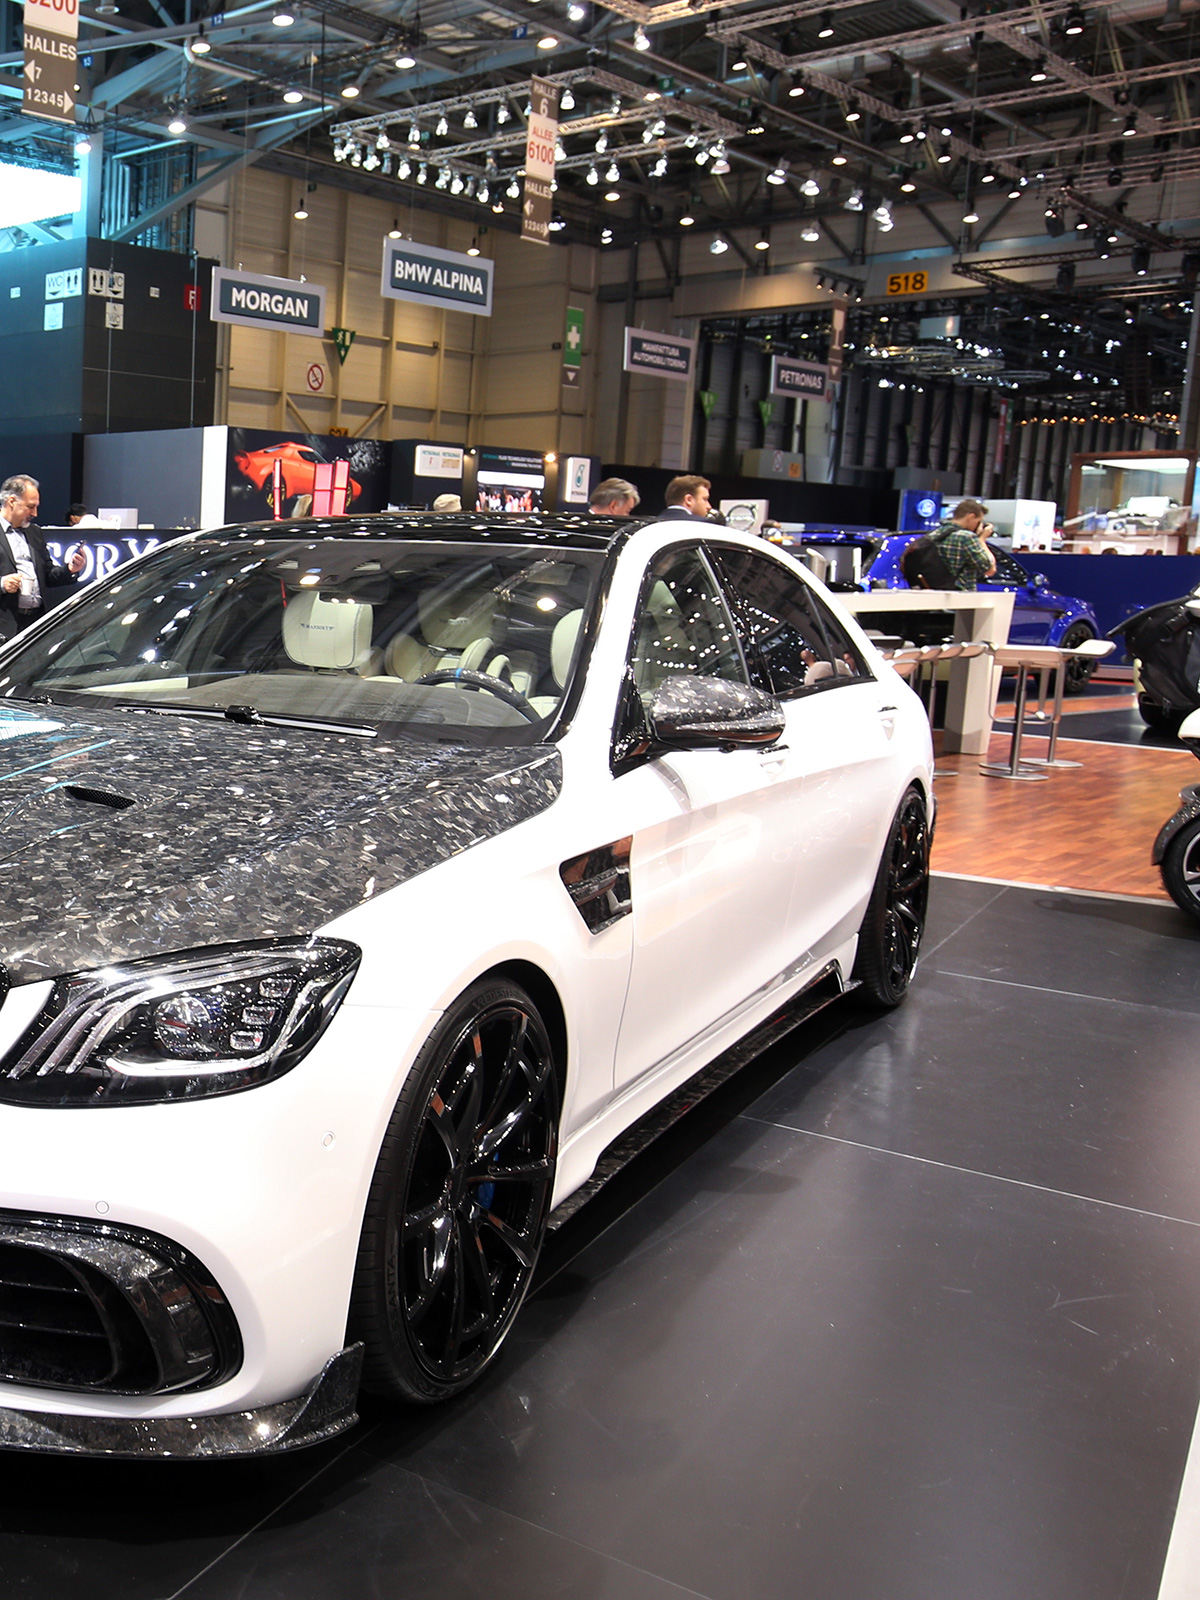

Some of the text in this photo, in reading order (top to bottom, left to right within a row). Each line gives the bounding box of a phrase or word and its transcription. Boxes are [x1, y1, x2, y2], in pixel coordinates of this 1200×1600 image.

[29, 0, 77, 14] 00
[24, 33, 77, 61] HALLES
[35, 66, 42, 79] 7
[533, 81, 557, 98] HALLE
[539, 98, 549, 118] 6
[528, 142, 555, 164] 6100
[524, 179, 553, 199] HALLES
[47, 275, 63, 288] WC
[394, 259, 484, 295] BMW ALPINA
[889, 273, 925, 293] 518
[231, 286, 309, 319] MORGAN
[780, 369, 823, 389] PETRONAS
